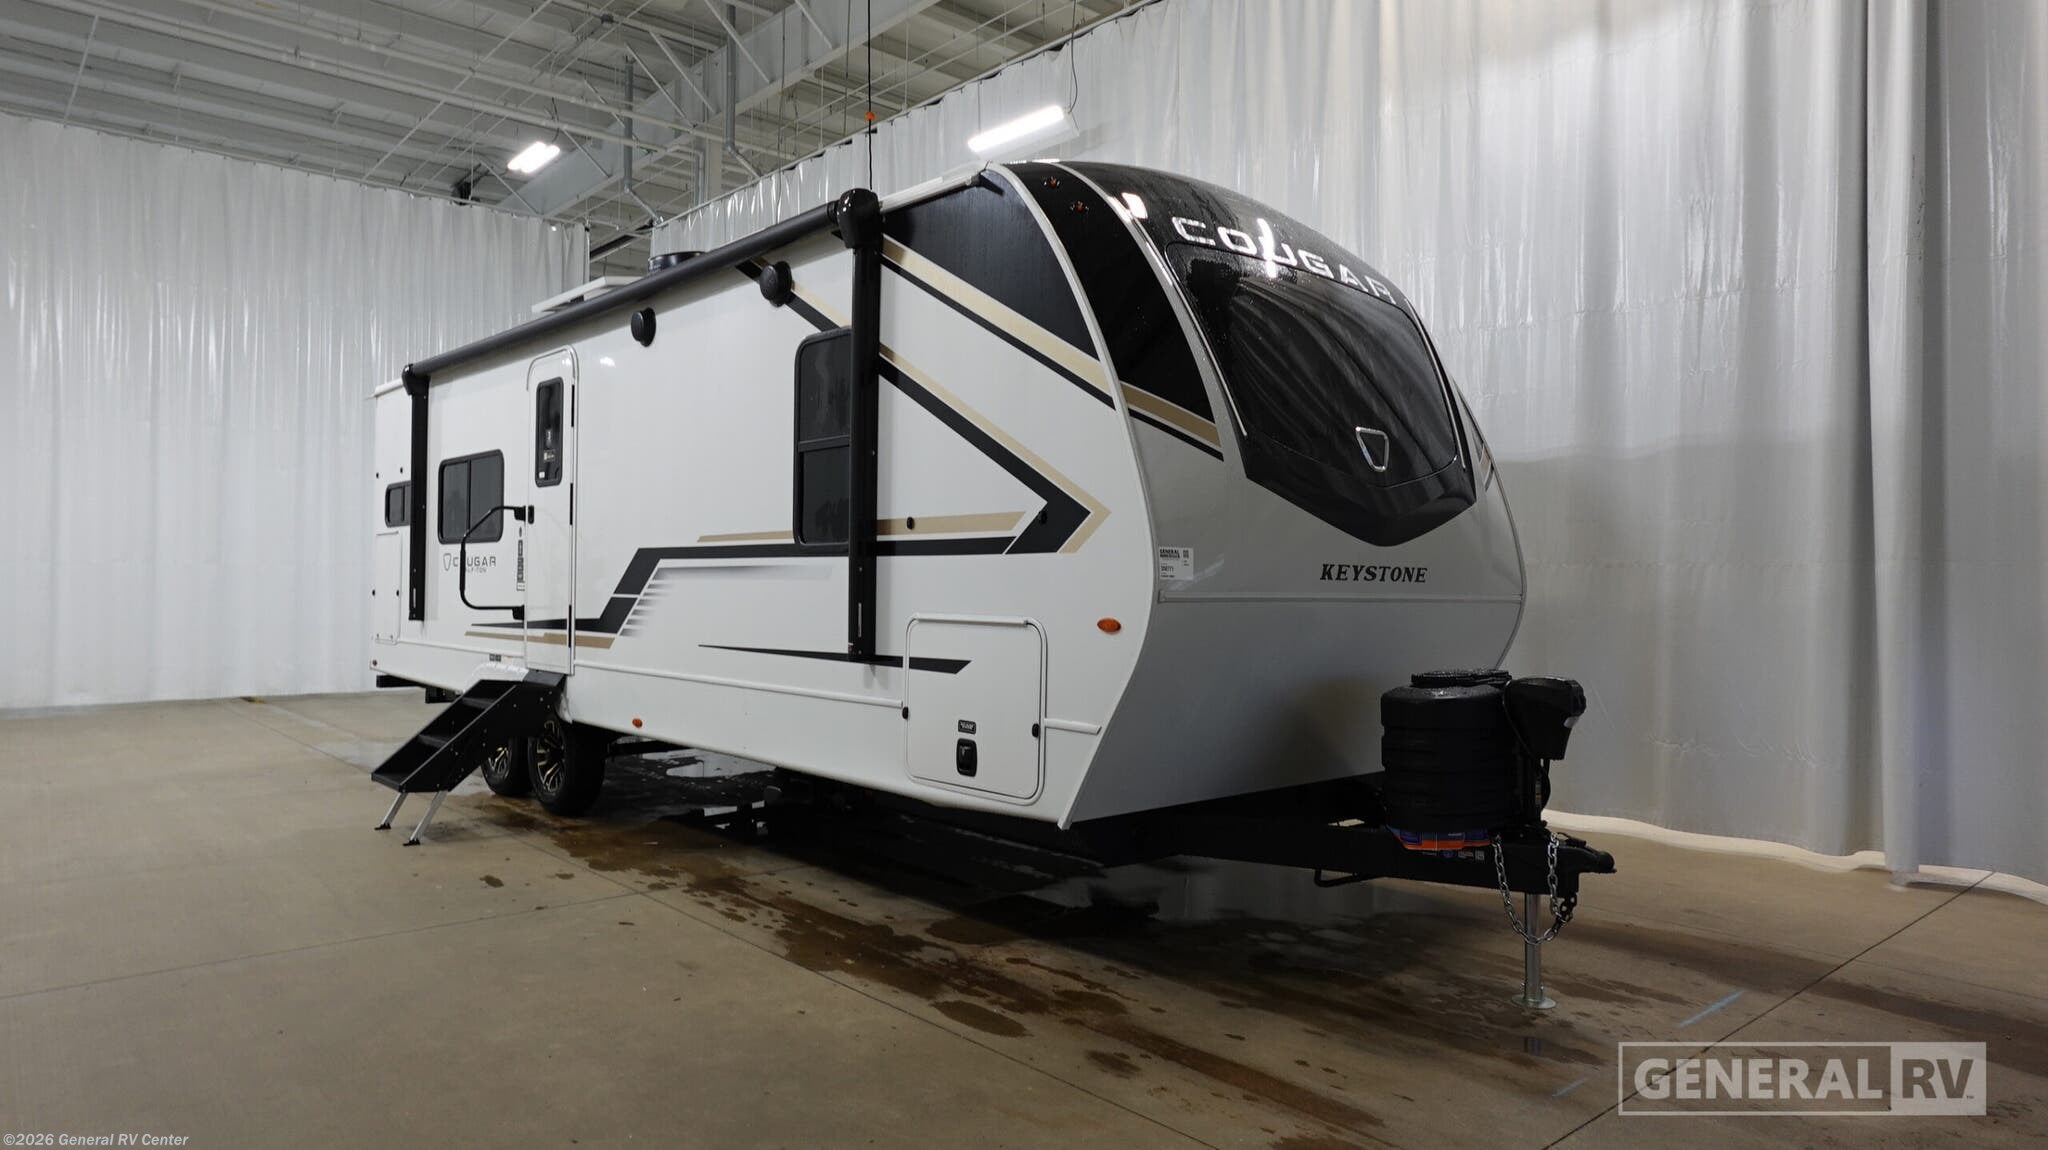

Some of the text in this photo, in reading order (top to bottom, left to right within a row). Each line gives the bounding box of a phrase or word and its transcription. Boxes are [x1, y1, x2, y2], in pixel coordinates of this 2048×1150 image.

[1171, 216, 1396, 304] COUGAR
[453, 556, 496, 567] CUGAR
[1320, 563, 1428, 583] KEYSTONE
